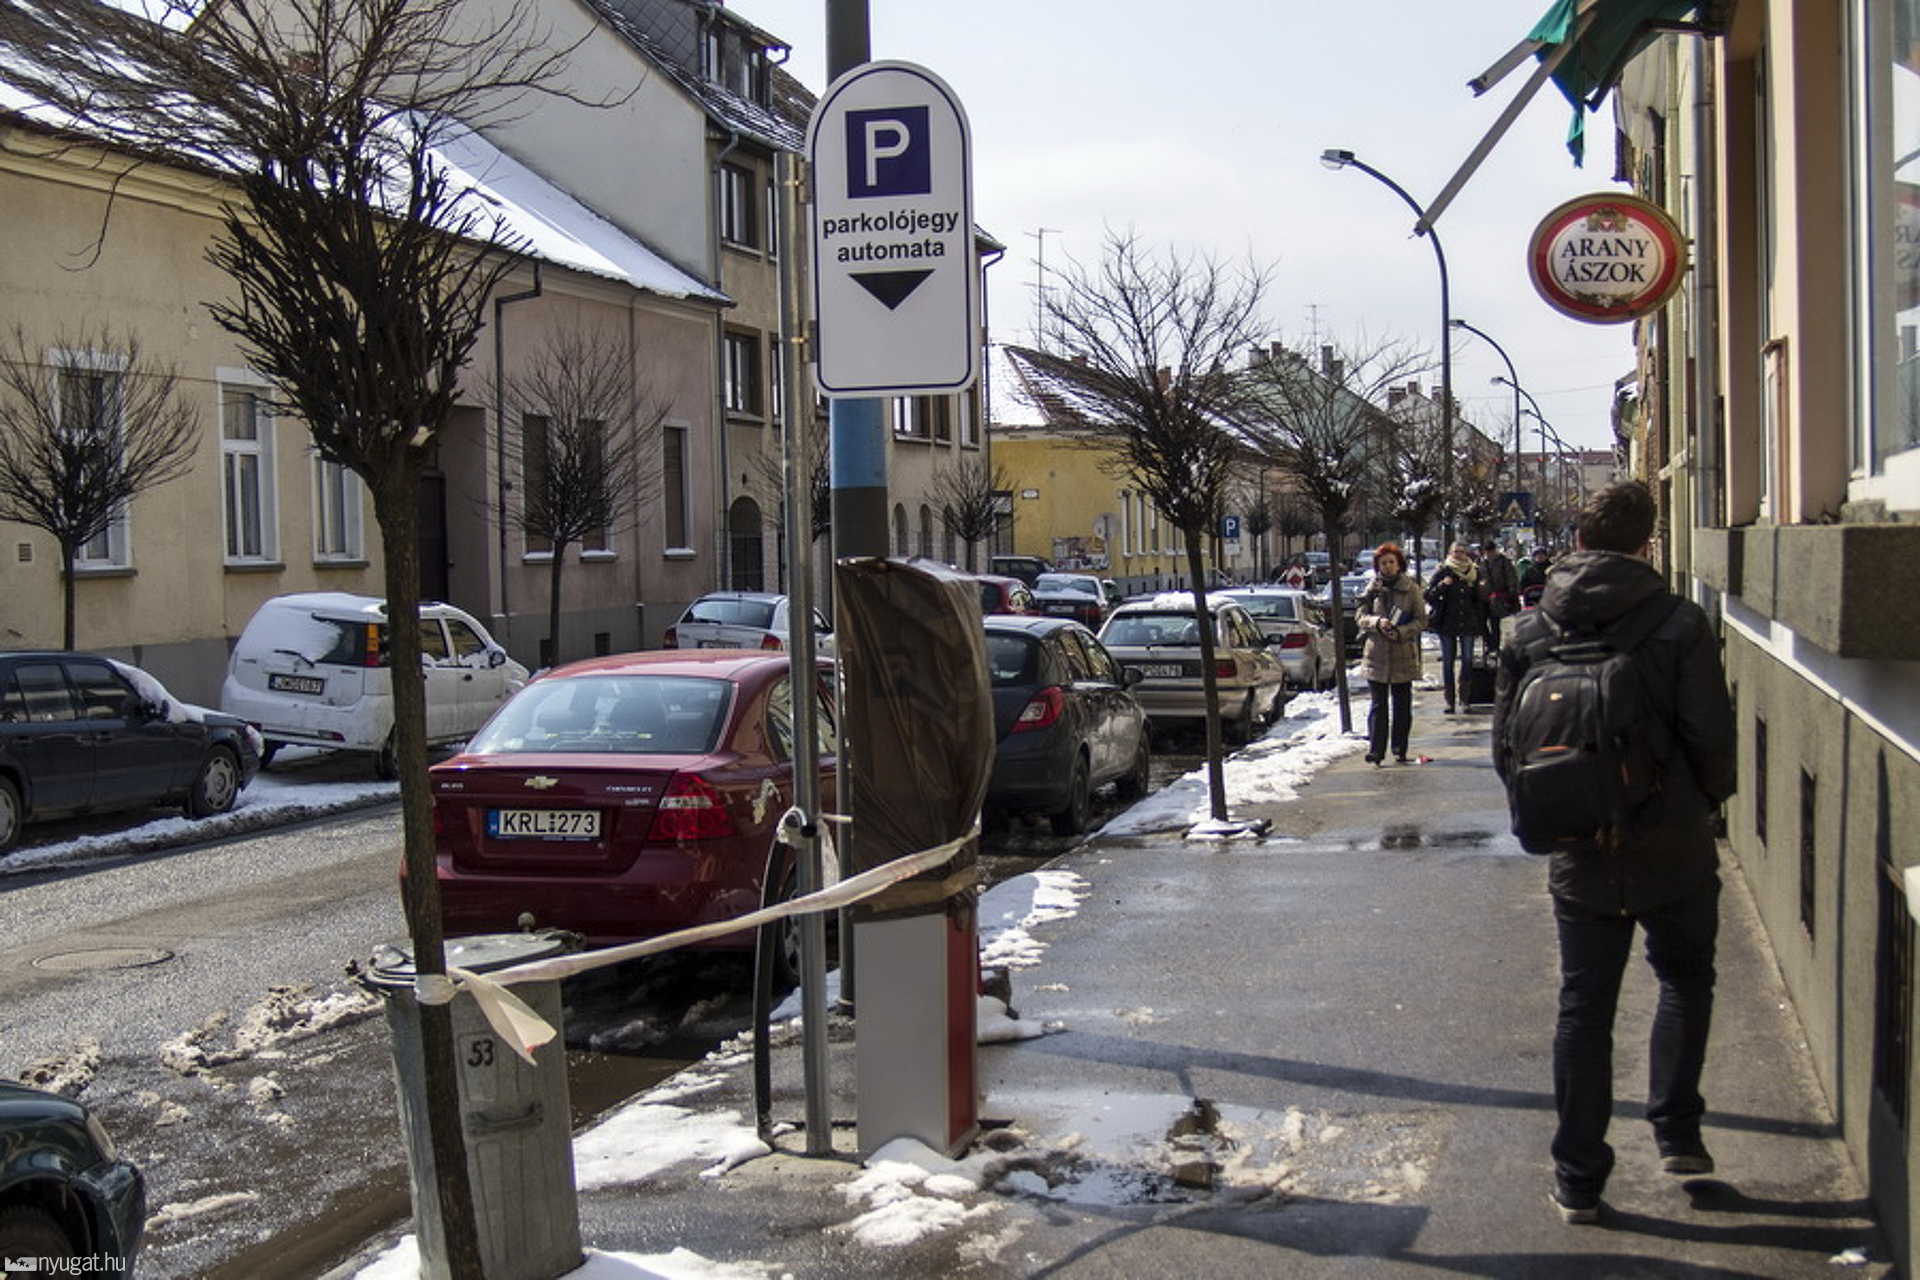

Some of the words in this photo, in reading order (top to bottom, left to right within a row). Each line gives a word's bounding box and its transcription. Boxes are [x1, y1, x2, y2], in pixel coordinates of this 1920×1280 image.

[865, 119, 911, 187] P
[822, 209, 960, 239] parkolójegy
[837, 239, 945, 263] automata
[1561, 238, 1650, 258] ARANY
[1563, 259, 1645, 282] ÁSZOK
[1226, 518, 1236, 536] P
[467, 1038, 494, 1067] 53
